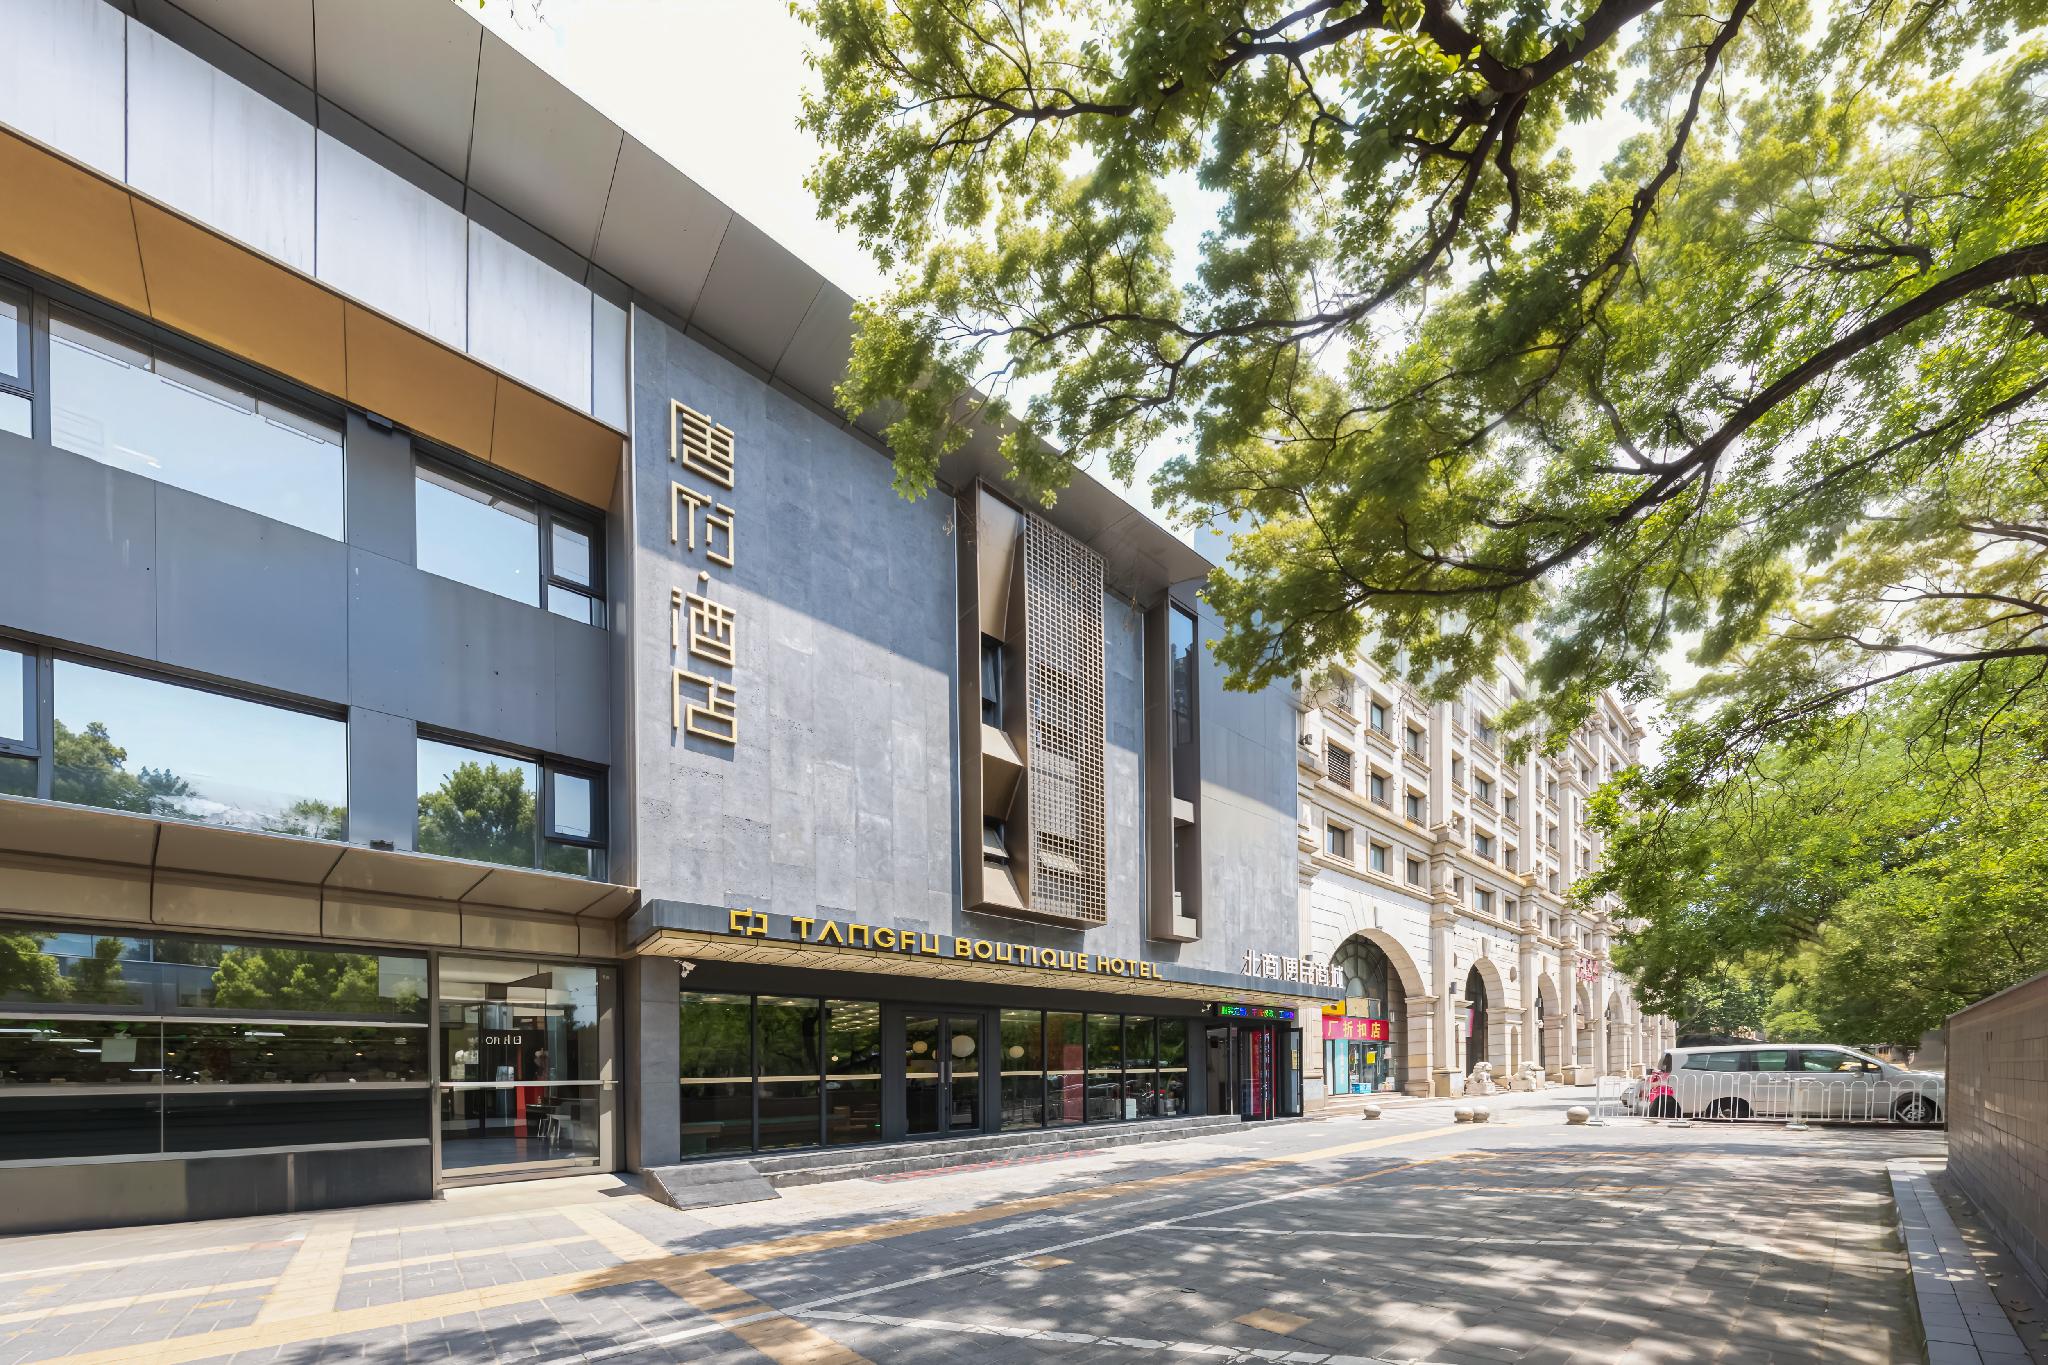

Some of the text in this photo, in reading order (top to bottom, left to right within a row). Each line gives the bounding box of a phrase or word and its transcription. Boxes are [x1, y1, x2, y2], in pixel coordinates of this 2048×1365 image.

[792, 916, 1163, 979] TANGFU BOUTIQUE HOTEL
